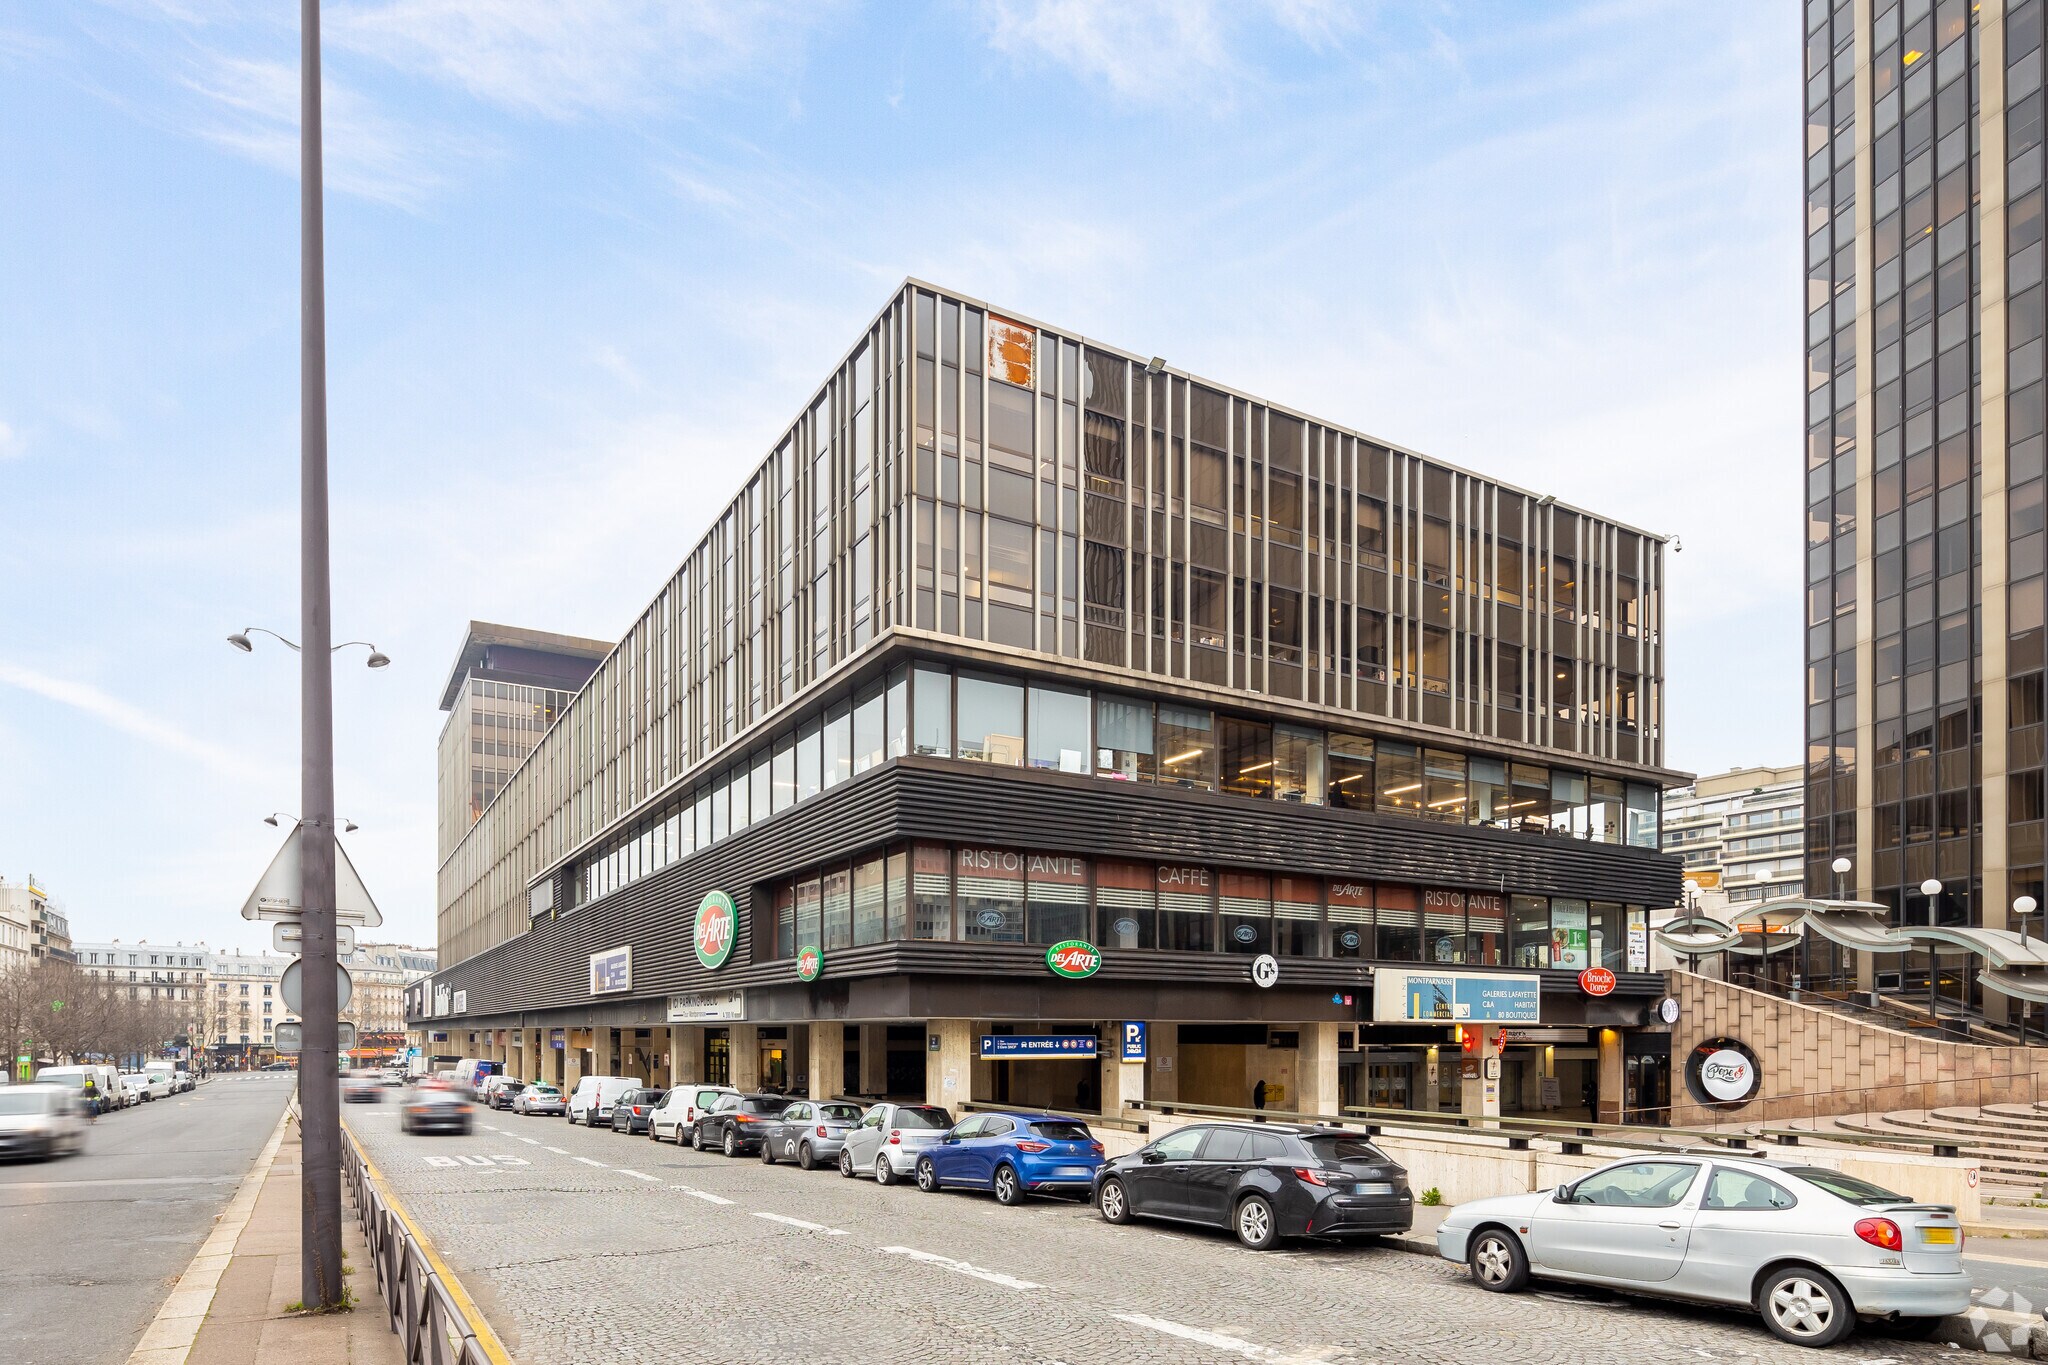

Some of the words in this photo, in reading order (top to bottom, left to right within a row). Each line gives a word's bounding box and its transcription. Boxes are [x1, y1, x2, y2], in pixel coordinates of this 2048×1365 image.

[1158, 865, 1209, 887] CAFFÈ
[1055, 941, 1095, 953] RISTORANTE
[1407, 977, 1453, 986] MONTPARNASSE
[1587, 971, 1613, 984] Brioche
[680, 994, 701, 1008] PARKING
[701, 992, 719, 1007] PUBLIC
[1482, 990, 1507, 998] GALERIES
[1508, 991, 1537, 999] LAFAYETTE
[1498, 1011, 1505, 1019] 80
[1506, 1011, 1537, 1020] BOUTIQUES
[1126, 1024, 1140, 1042] P
[983, 1039, 992, 1050] P
[1028, 1040, 1054, 1048] ENTRÉE
[421, 1155, 532, 1167] BUS
